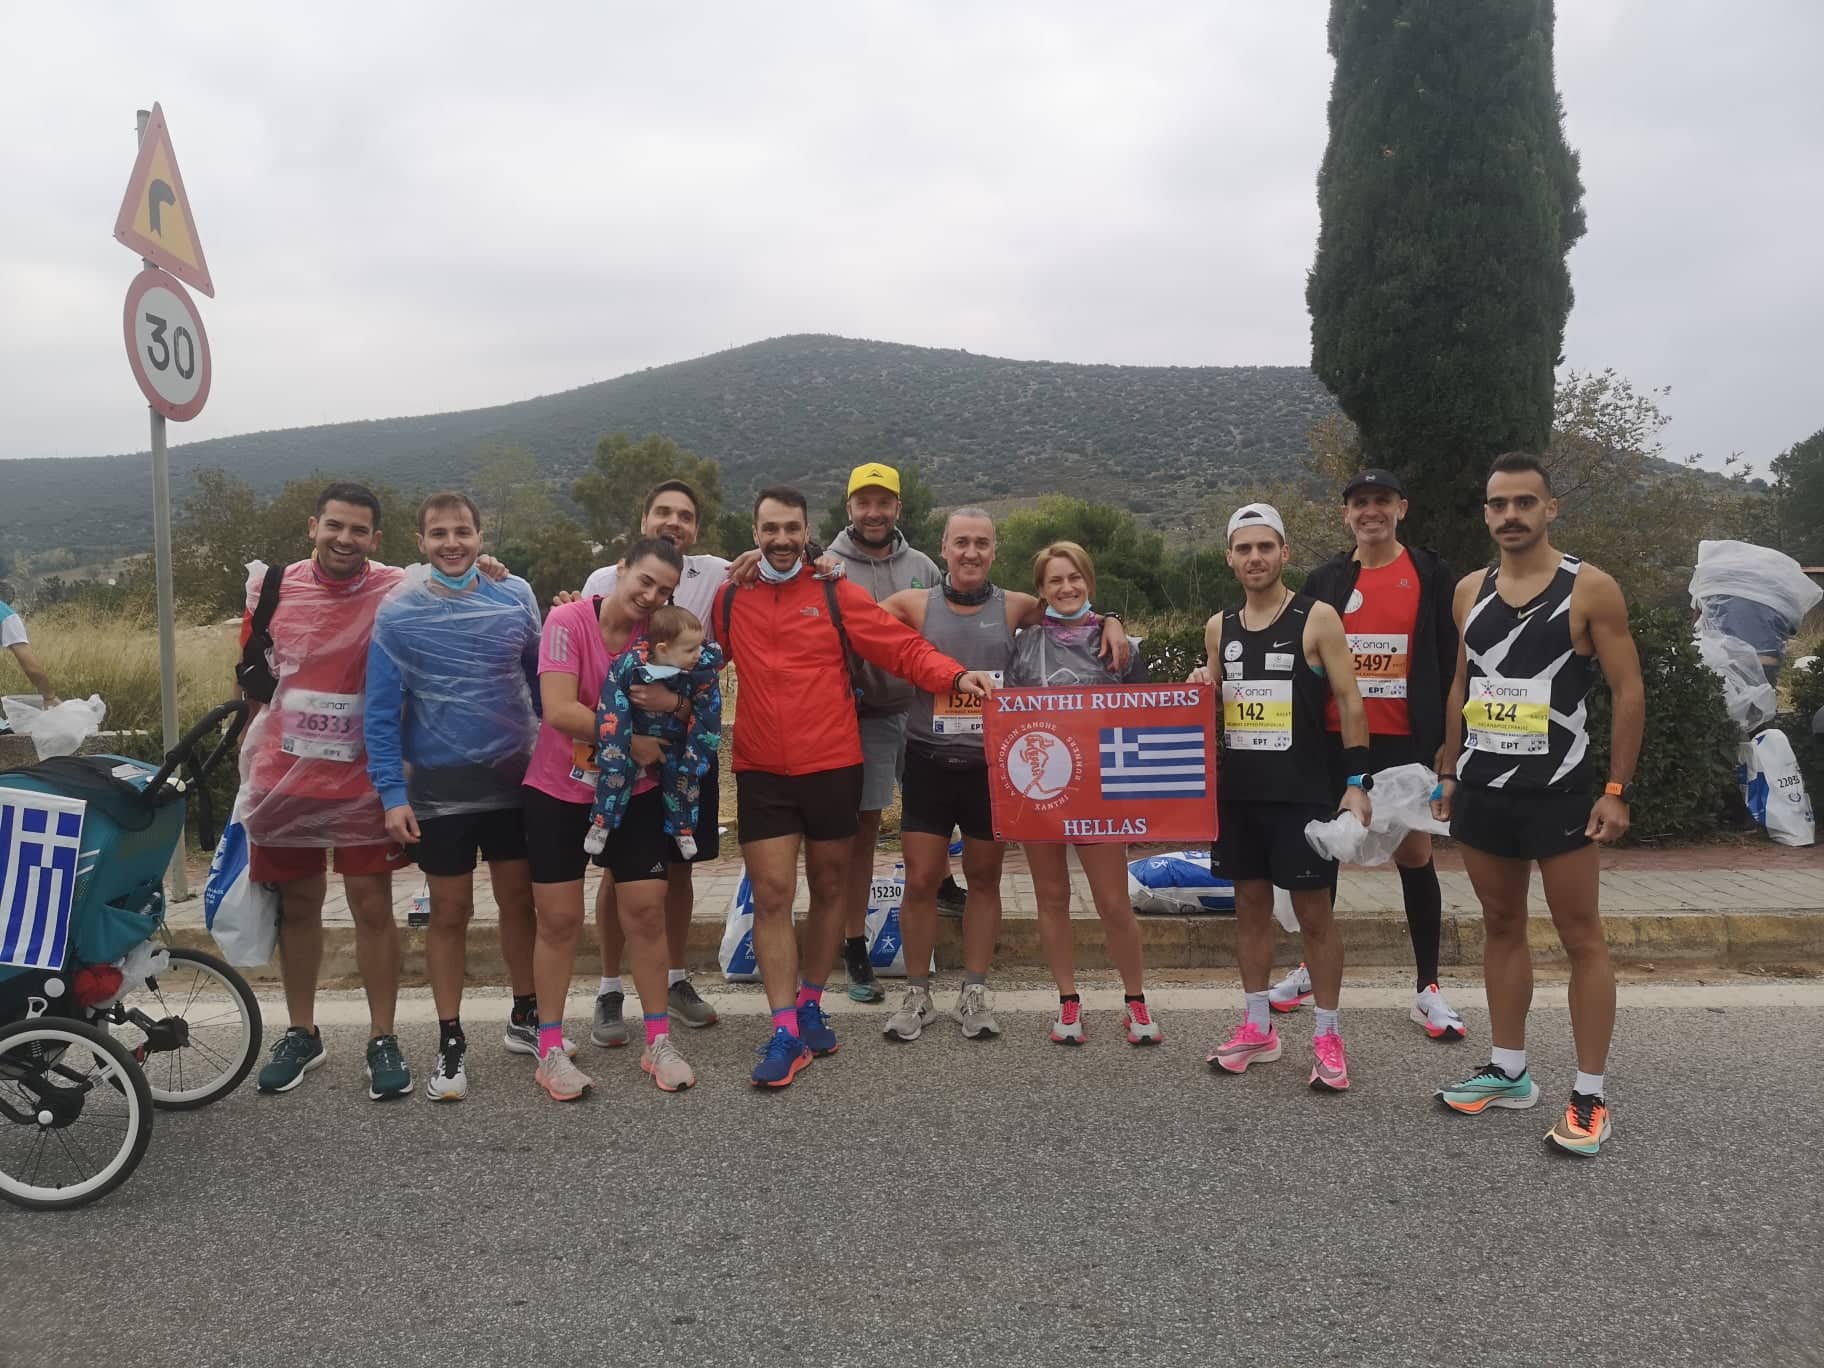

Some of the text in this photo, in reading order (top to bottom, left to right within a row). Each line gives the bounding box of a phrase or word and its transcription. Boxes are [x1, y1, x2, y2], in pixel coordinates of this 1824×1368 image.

[146, 312, 194, 380] 30
[998, 689, 1200, 712] XANTHI RUNNERS
[1237, 702, 1264, 720] 142
[1484, 702, 1517, 722] 124
[296, 711, 351, 734] 26333
[1063, 818, 1147, 836] HELLAS
[872, 886, 902, 899] 15230
